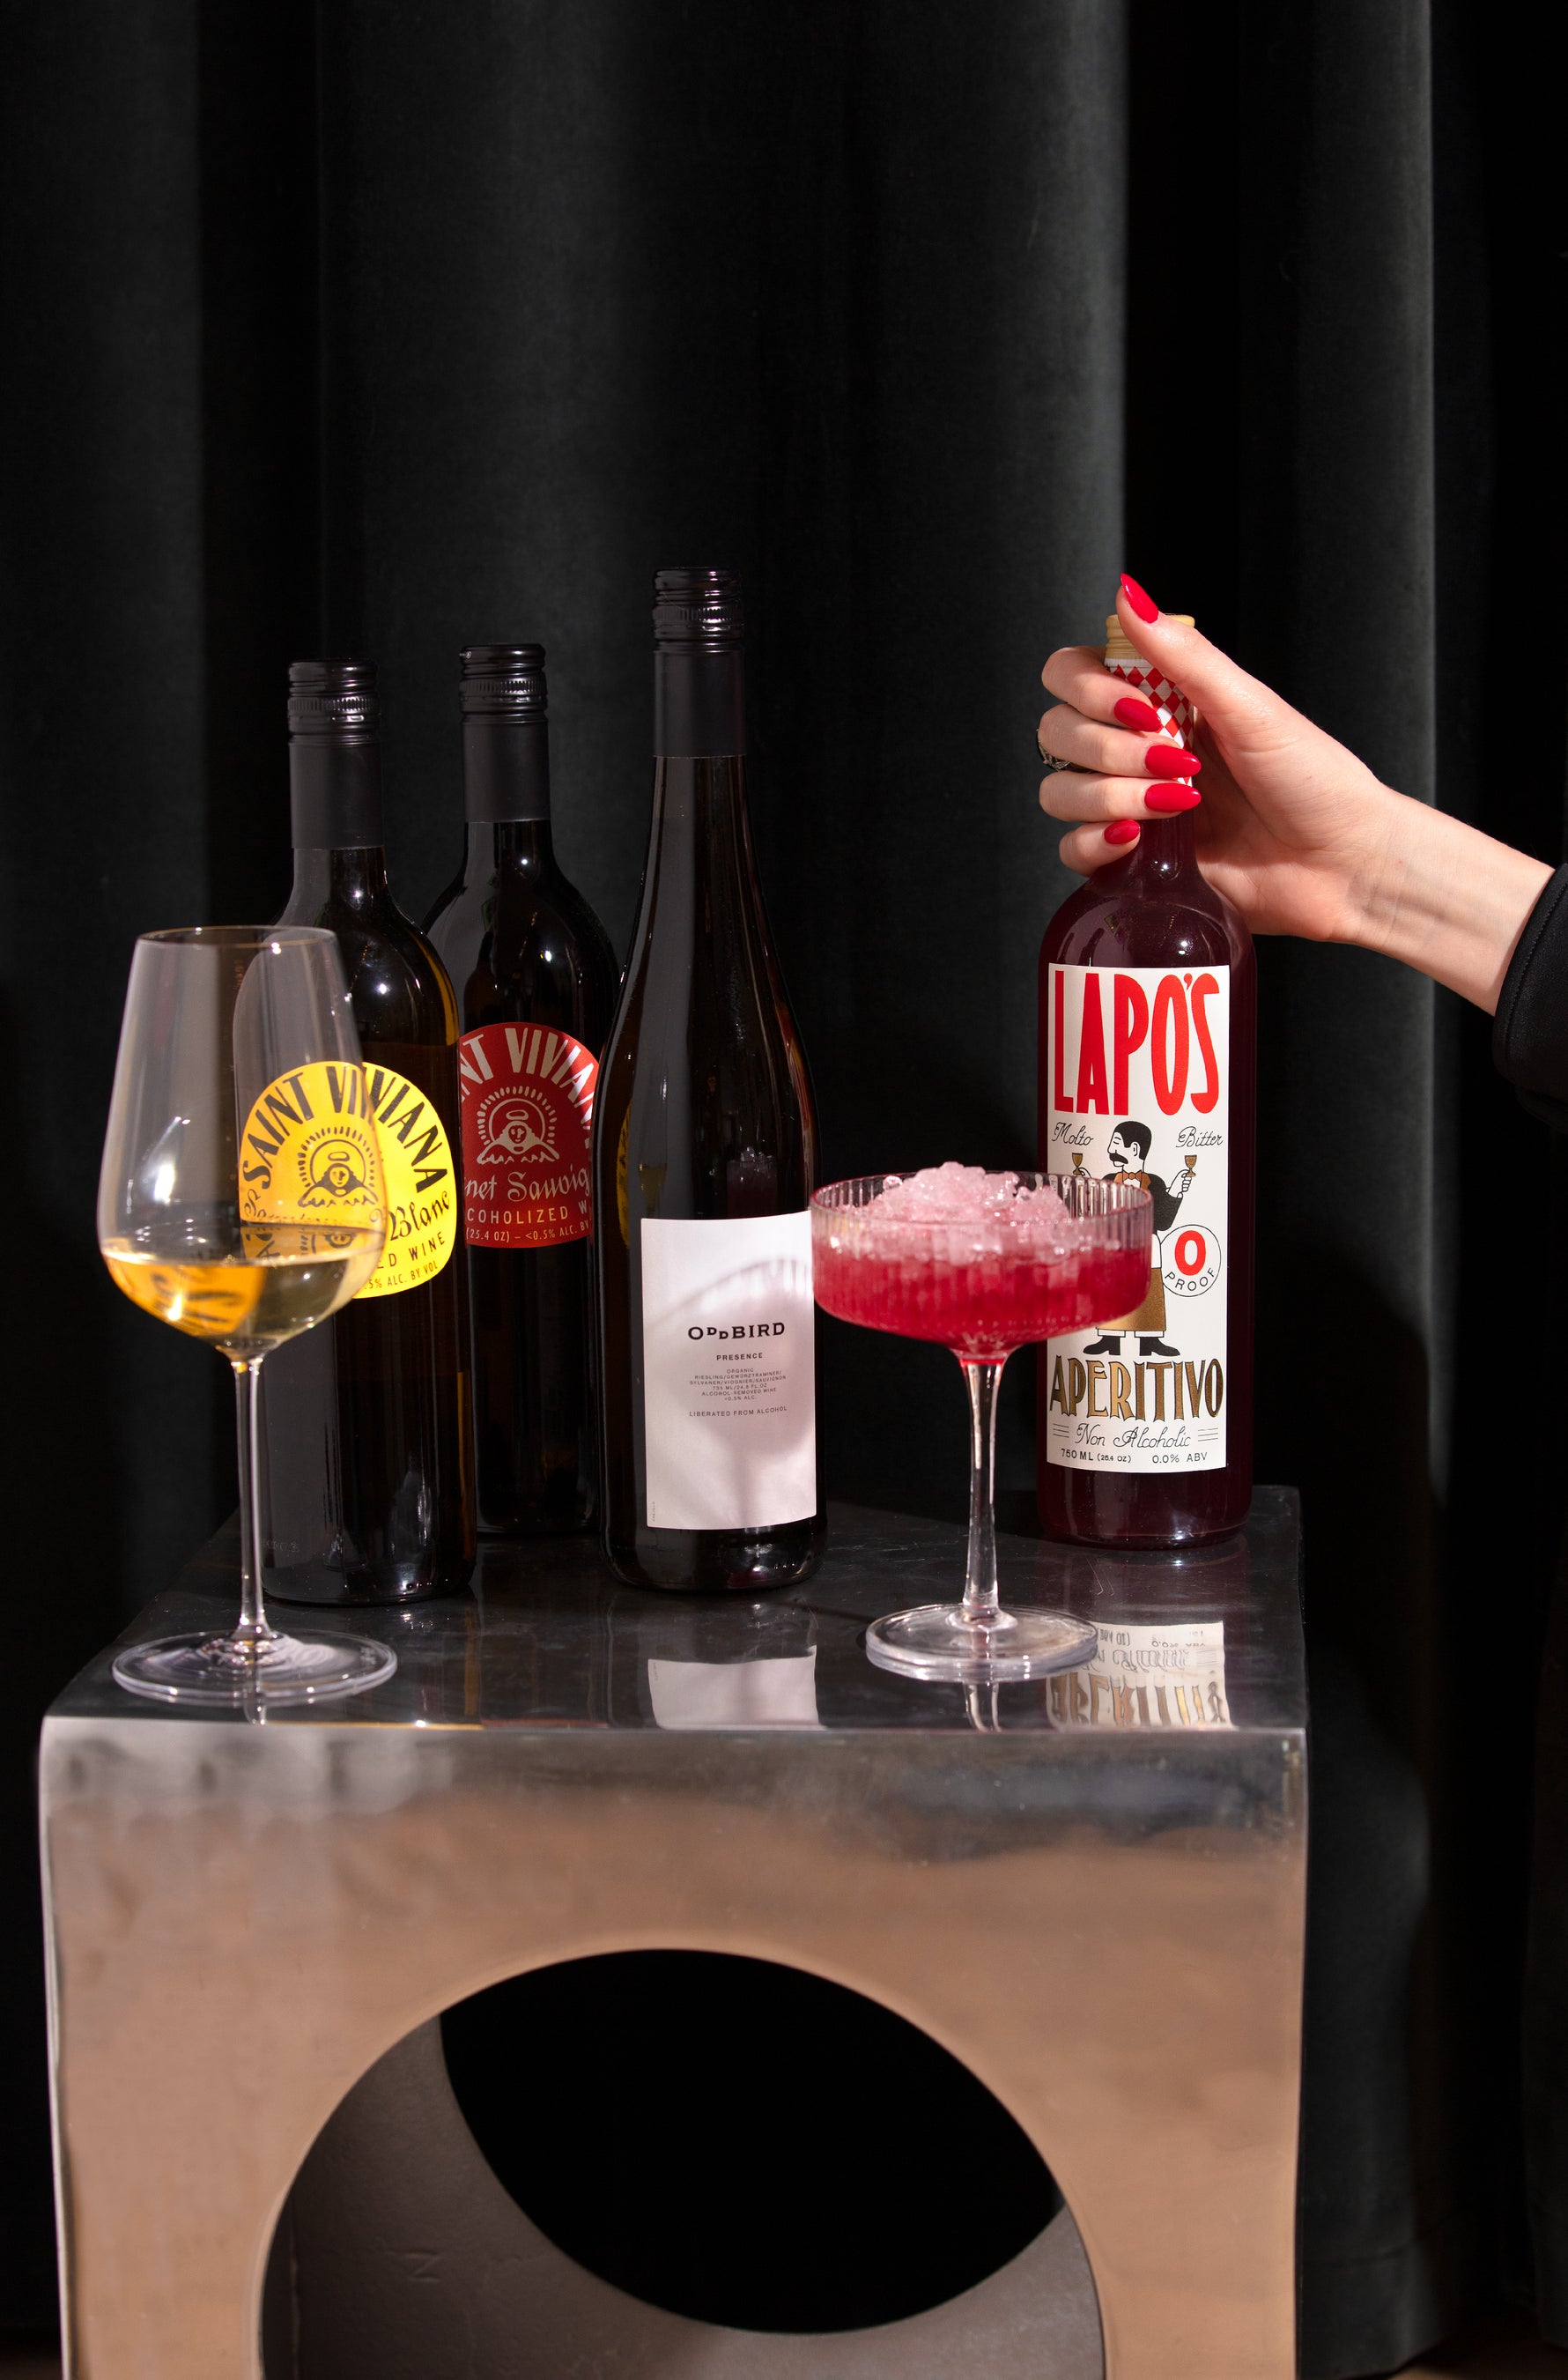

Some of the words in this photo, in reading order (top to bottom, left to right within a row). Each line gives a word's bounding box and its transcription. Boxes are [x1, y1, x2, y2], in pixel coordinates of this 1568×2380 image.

[1054, 970, 1220, 1116] LAPO'S
[504, 1027, 595, 1149] VIVIA
[242, 1071, 314, 1190] SAINT
[325, 1066, 447, 1193] VIVIANA
[1052, 1121, 1094, 1146] Molto
[1175, 1125, 1224, 1148] Bitter
[464, 1174, 498, 1201] net
[388, 1190, 450, 1242] Blanc
[467, 1205, 568, 1225] COHOLIZED
[408, 1231, 446, 1261] WINE
[493, 1230, 510, 1243] OZ)
[559, 1225, 578, 1237] ALC.
[388, 1273, 407, 1286] ALC.
[410, 1267, 421, 1280] BY
[423, 1260, 438, 1275] VOL
[1164, 1267, 1216, 1292] PROOF
[716, 1352, 764, 1361] PRESENCE
[1049, 1354, 1224, 1422] APERITIVO
[757, 1405, 788, 1414] ALCOHOL
[1075, 1422, 1106, 1447] Non
[1113, 1425, 1192, 1449] Alcoholic
[1061, 1448, 1077, 1458] 750
[1079, 1451, 1093, 1461] ML
[1117, 1454, 1132, 1464] OZ)
[1151, 1454, 1180, 1464] 0.0%
[1186, 1452, 1208, 1463] ABV
